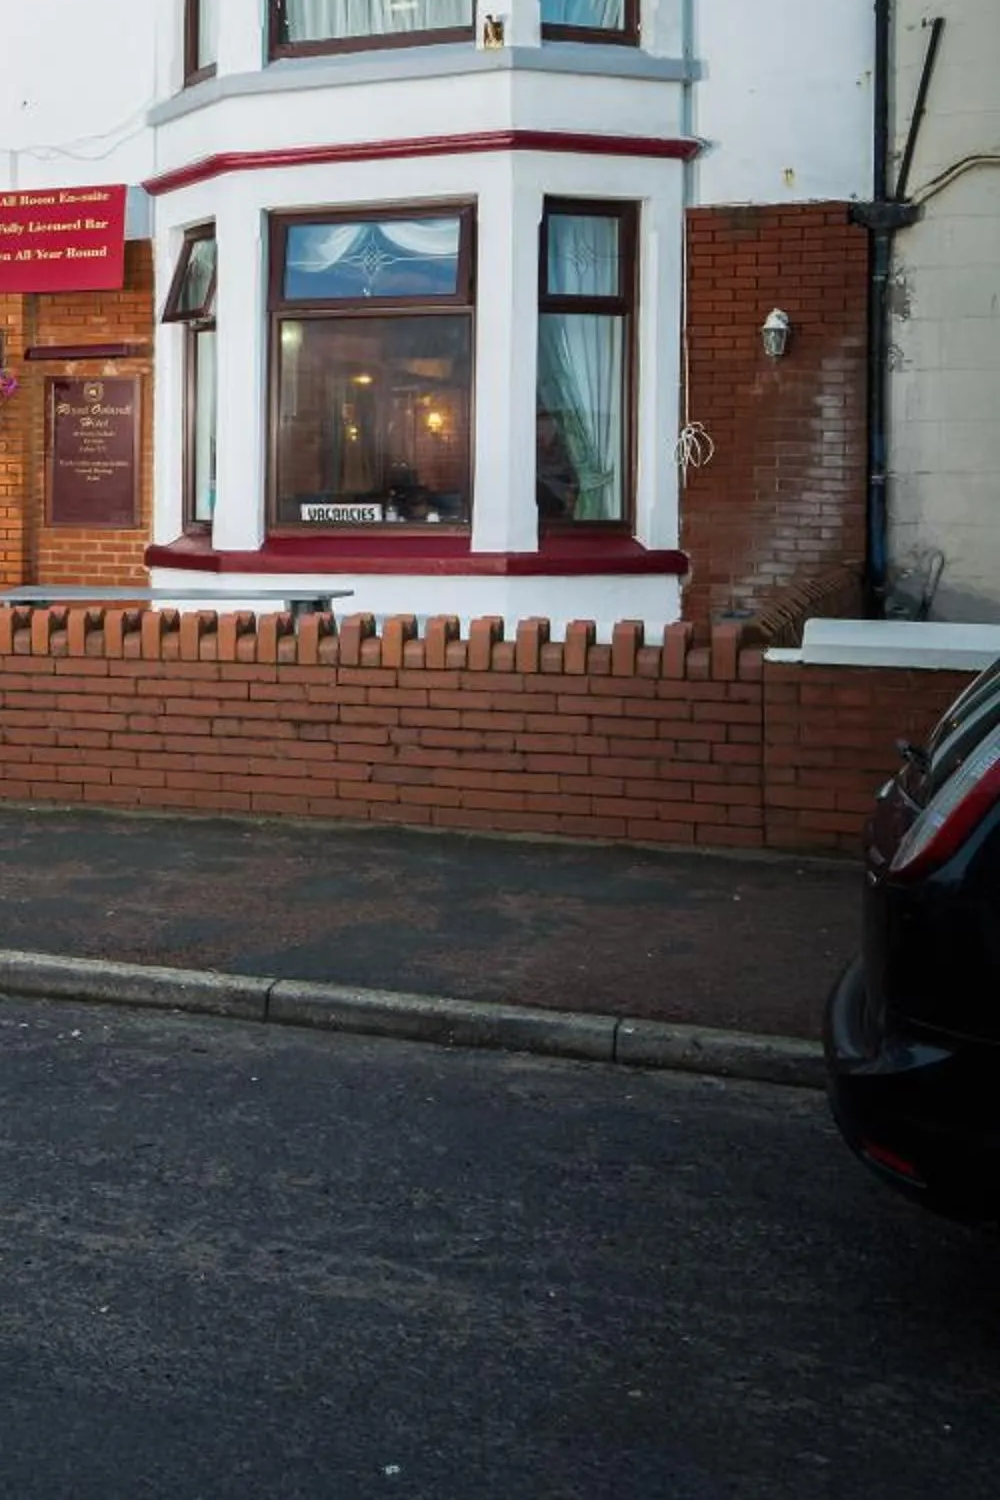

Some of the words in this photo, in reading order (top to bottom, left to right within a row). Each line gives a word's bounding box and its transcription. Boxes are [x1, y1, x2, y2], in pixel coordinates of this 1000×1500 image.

[0, 195, 17, 207] All
[19, 195, 56, 206] Room
[59, 190, 111, 204] En-suite
[28, 219, 82, 233] Licensed
[84, 218, 109, 230] Bar
[15, 248, 32, 261] All
[35, 248, 64, 260] Year
[66, 245, 108, 259] Round
[307, 507, 375, 521] VACANCIES
